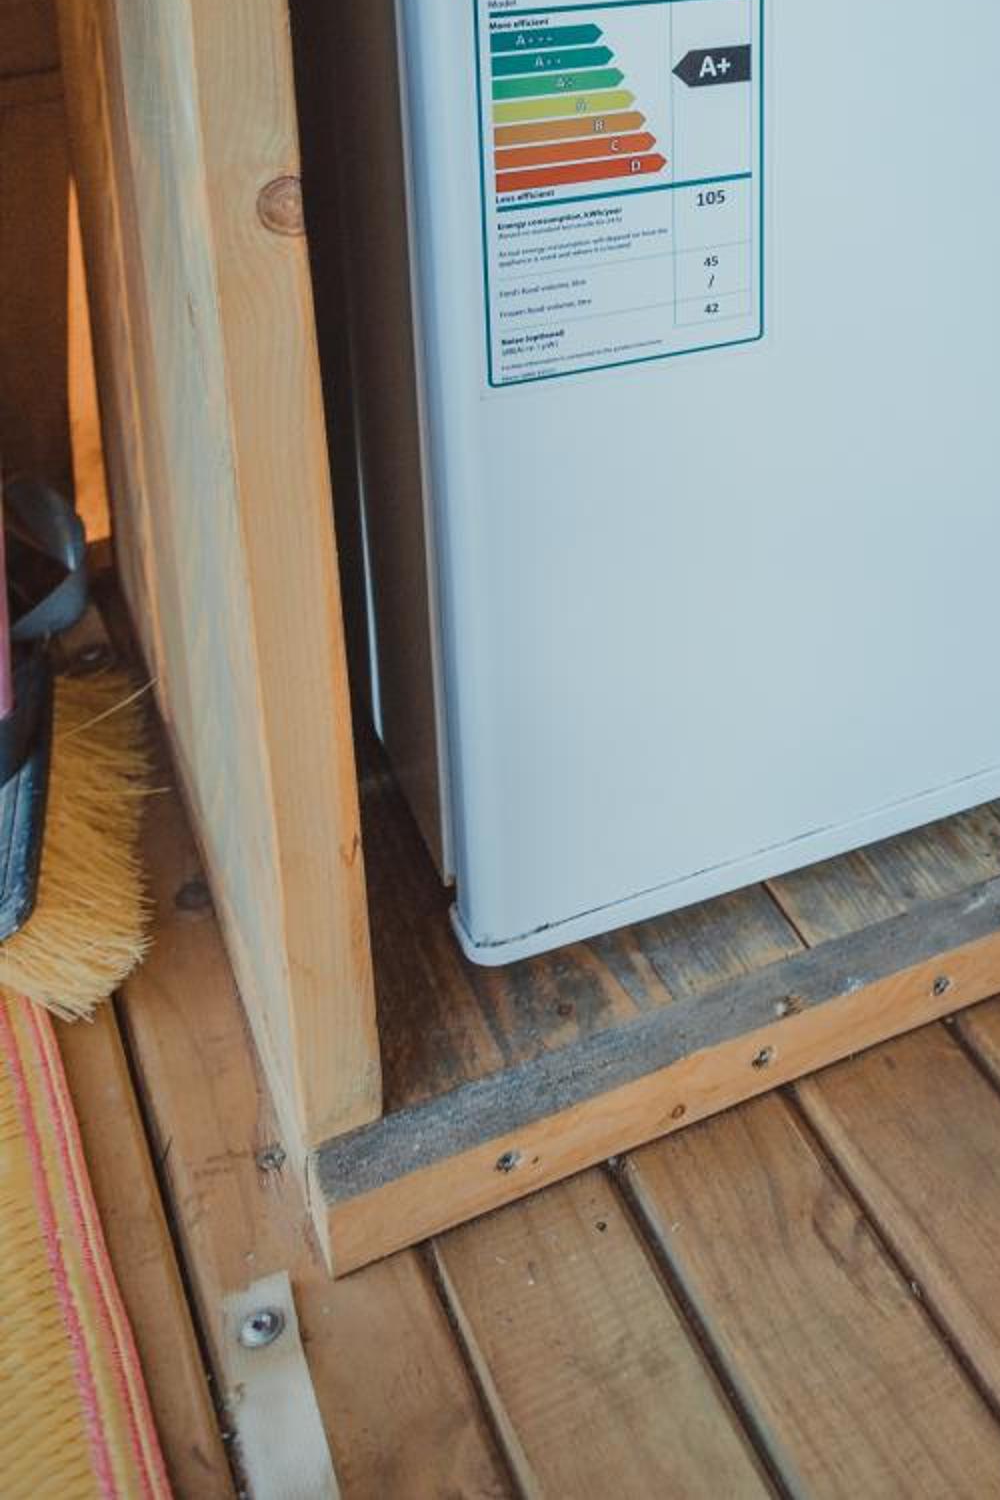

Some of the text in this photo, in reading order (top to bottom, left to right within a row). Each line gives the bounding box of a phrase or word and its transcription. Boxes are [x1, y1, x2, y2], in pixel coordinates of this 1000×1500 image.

[699, 55, 732, 78] A+
[697, 190, 726, 206] 105
[704, 256, 720, 267] 45
[704, 303, 720, 314] 42
